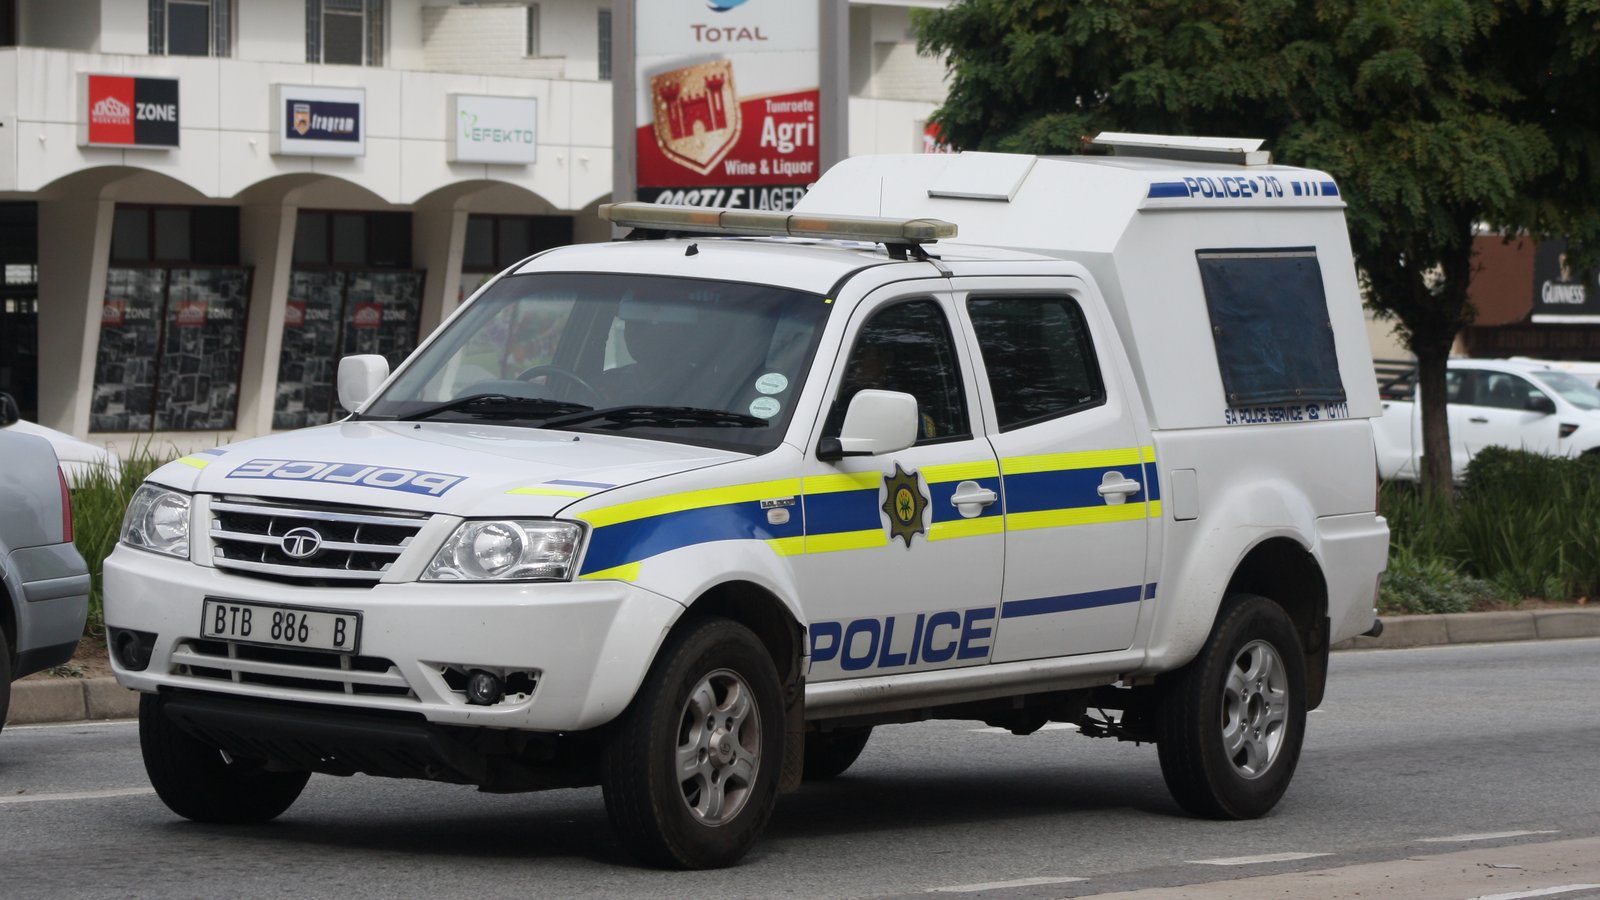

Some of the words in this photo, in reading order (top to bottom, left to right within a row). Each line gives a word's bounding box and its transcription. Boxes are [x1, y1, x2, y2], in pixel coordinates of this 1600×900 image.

[690, 24, 768, 42] TOTAL
[136, 103, 176, 121] ZONE
[472, 128, 534, 144] EFEKTO
[760, 115, 814, 154] Agri
[724, 159, 756, 175] Wine
[760, 159, 770, 174] &
[773, 159, 814, 177] Liquor
[1183, 176, 1252, 198] POLICE
[1542, 281, 1585, 304] GUINNESS
[125, 308, 151, 319] ZONE
[208, 308, 233, 319] ZONE
[305, 309, 330, 320] ZONE
[382, 309, 407, 320] ZONE
[1225, 408, 1238, 424] SA
[1240, 407, 1267, 424] POLICE
[1268, 404, 1303, 422] SERVICE
[1324, 402, 1349, 418] 10111
[214, 605, 252, 637] BTB
[271, 611, 309, 643] 886
[333, 617, 346, 647] B
[808, 607, 996, 674] POLICE
